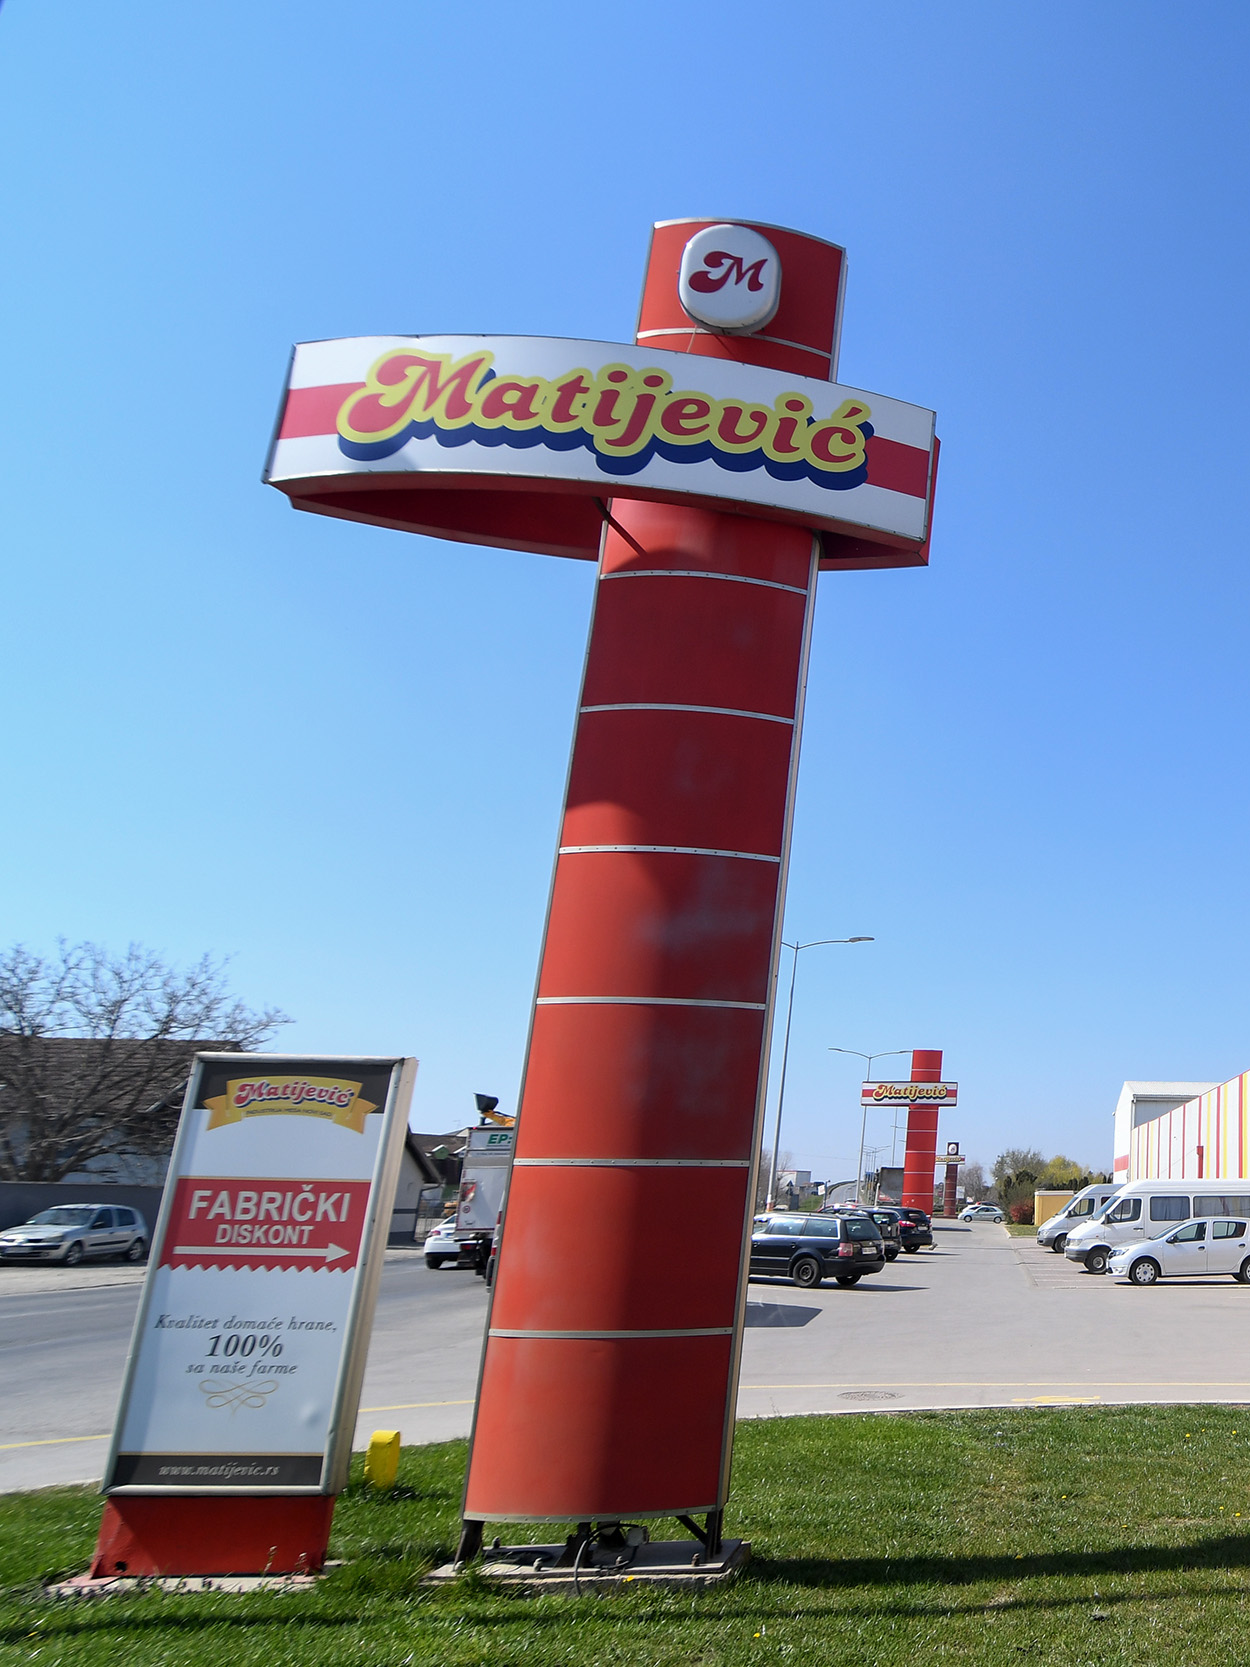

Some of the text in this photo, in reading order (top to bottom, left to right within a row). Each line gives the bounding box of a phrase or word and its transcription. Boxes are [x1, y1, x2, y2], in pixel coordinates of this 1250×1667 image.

[688, 250, 768, 294] M
[343, 351, 870, 468] Matijević
[234, 1081, 352, 1107] Matijević
[873, 1084, 948, 1100] Matijević
[188, 1184, 351, 1222] FABRIČKI
[215, 1224, 314, 1244] DISKONT
[223, 1315, 283, 1330] domaće
[287, 1316, 337, 1333] hrane,
[205, 1333, 284, 1358] 100%
[185, 1360, 298, 1377] sa naše farme
[158, 1461, 280, 1479] www.matijevic.rs
